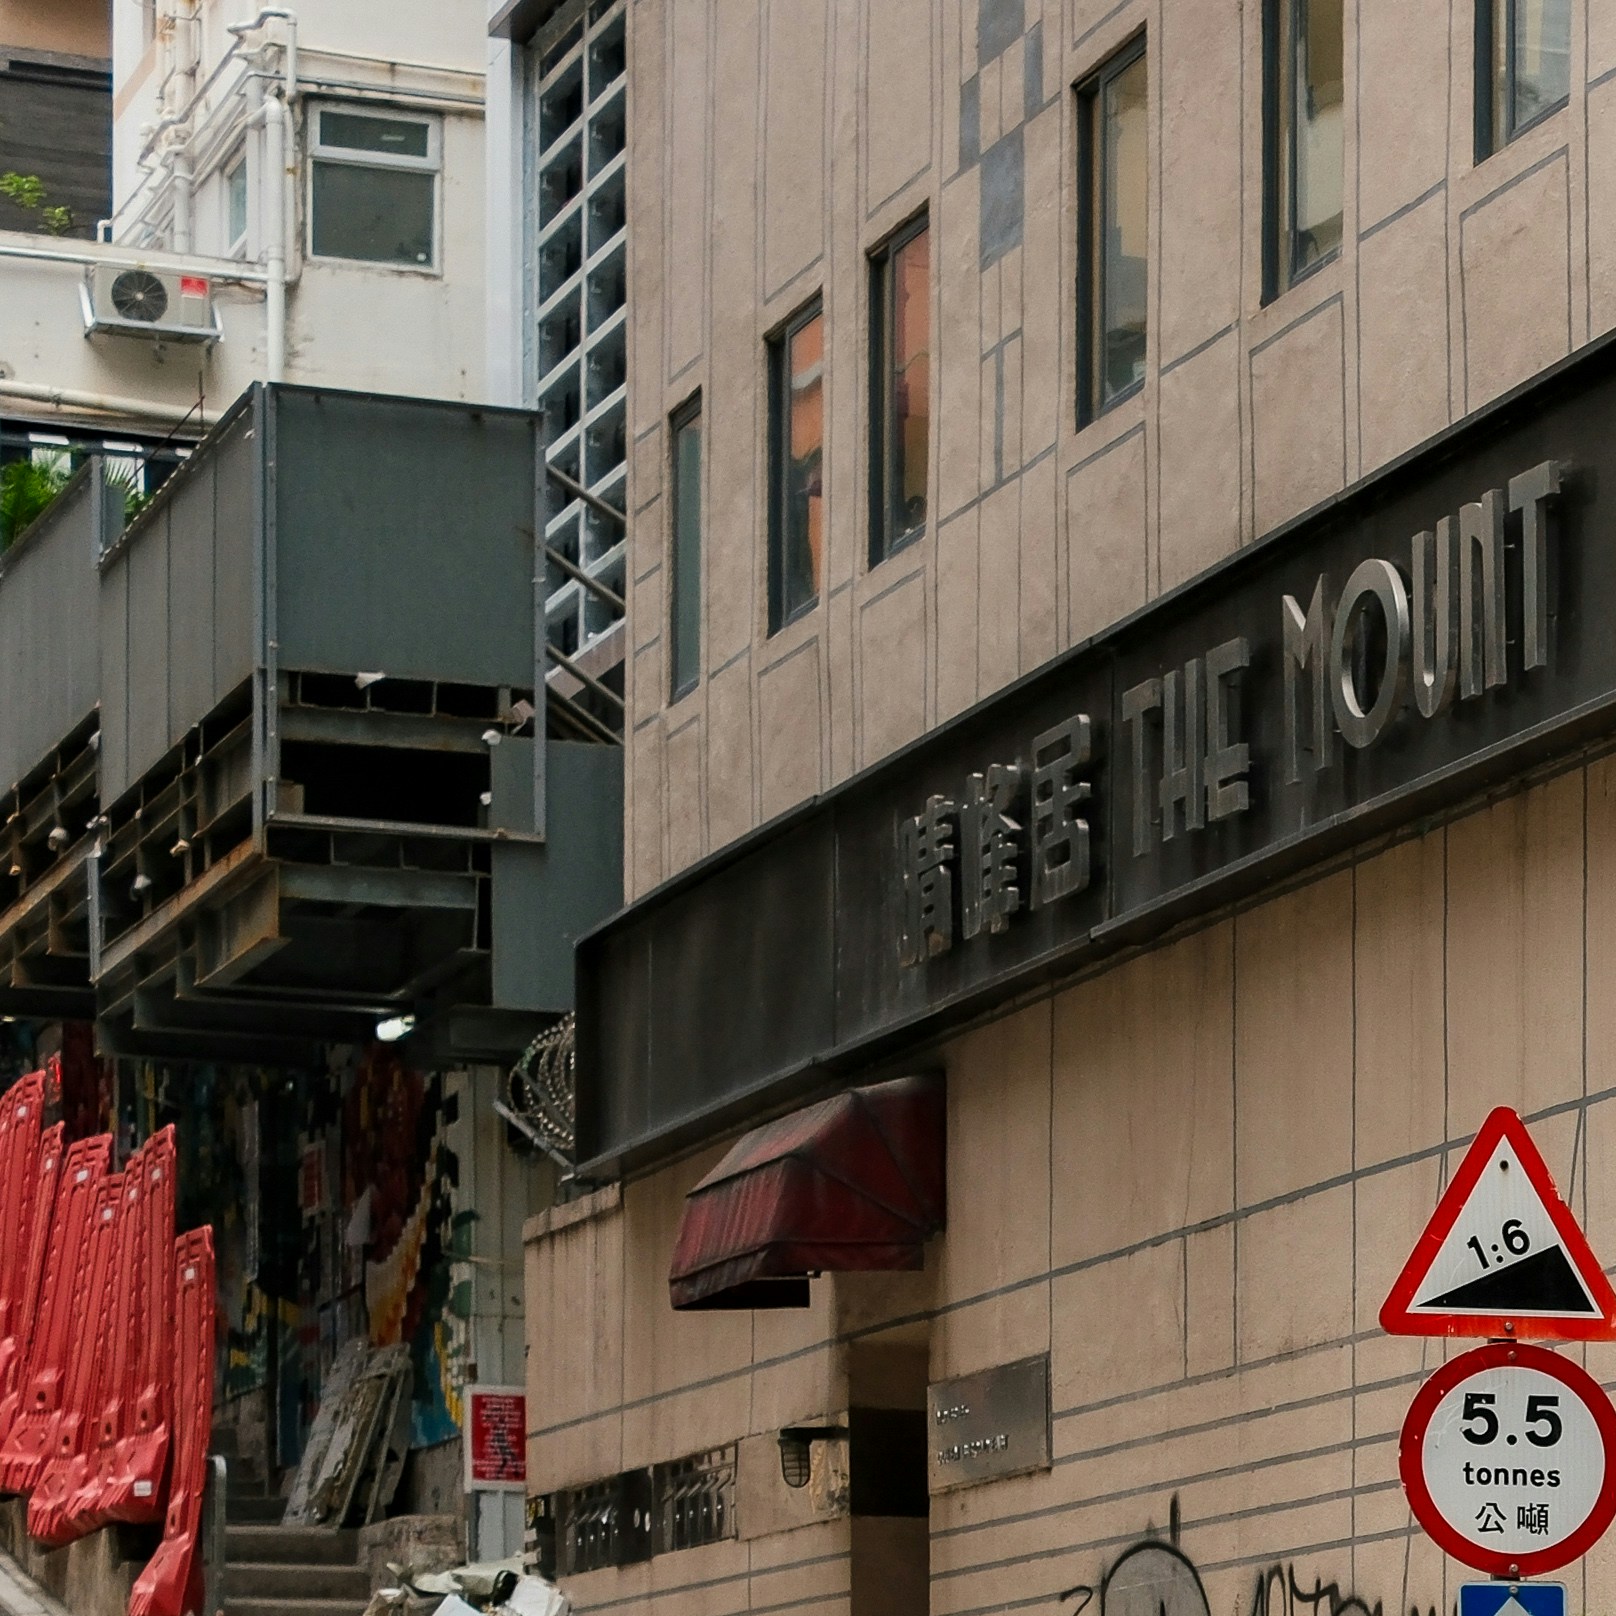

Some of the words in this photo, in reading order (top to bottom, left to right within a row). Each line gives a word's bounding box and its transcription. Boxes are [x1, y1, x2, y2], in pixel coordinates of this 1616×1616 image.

[1121, 636, 1253, 857] THE
[1282, 457, 1570, 787] MOUNT
[1466, 1218, 1532, 1271] 1:6
[1461, 1393, 1564, 1449] 5.5
[1462, 1460, 1562, 1489] tonnes
[1474, 1501, 1551, 1537] 公噸
